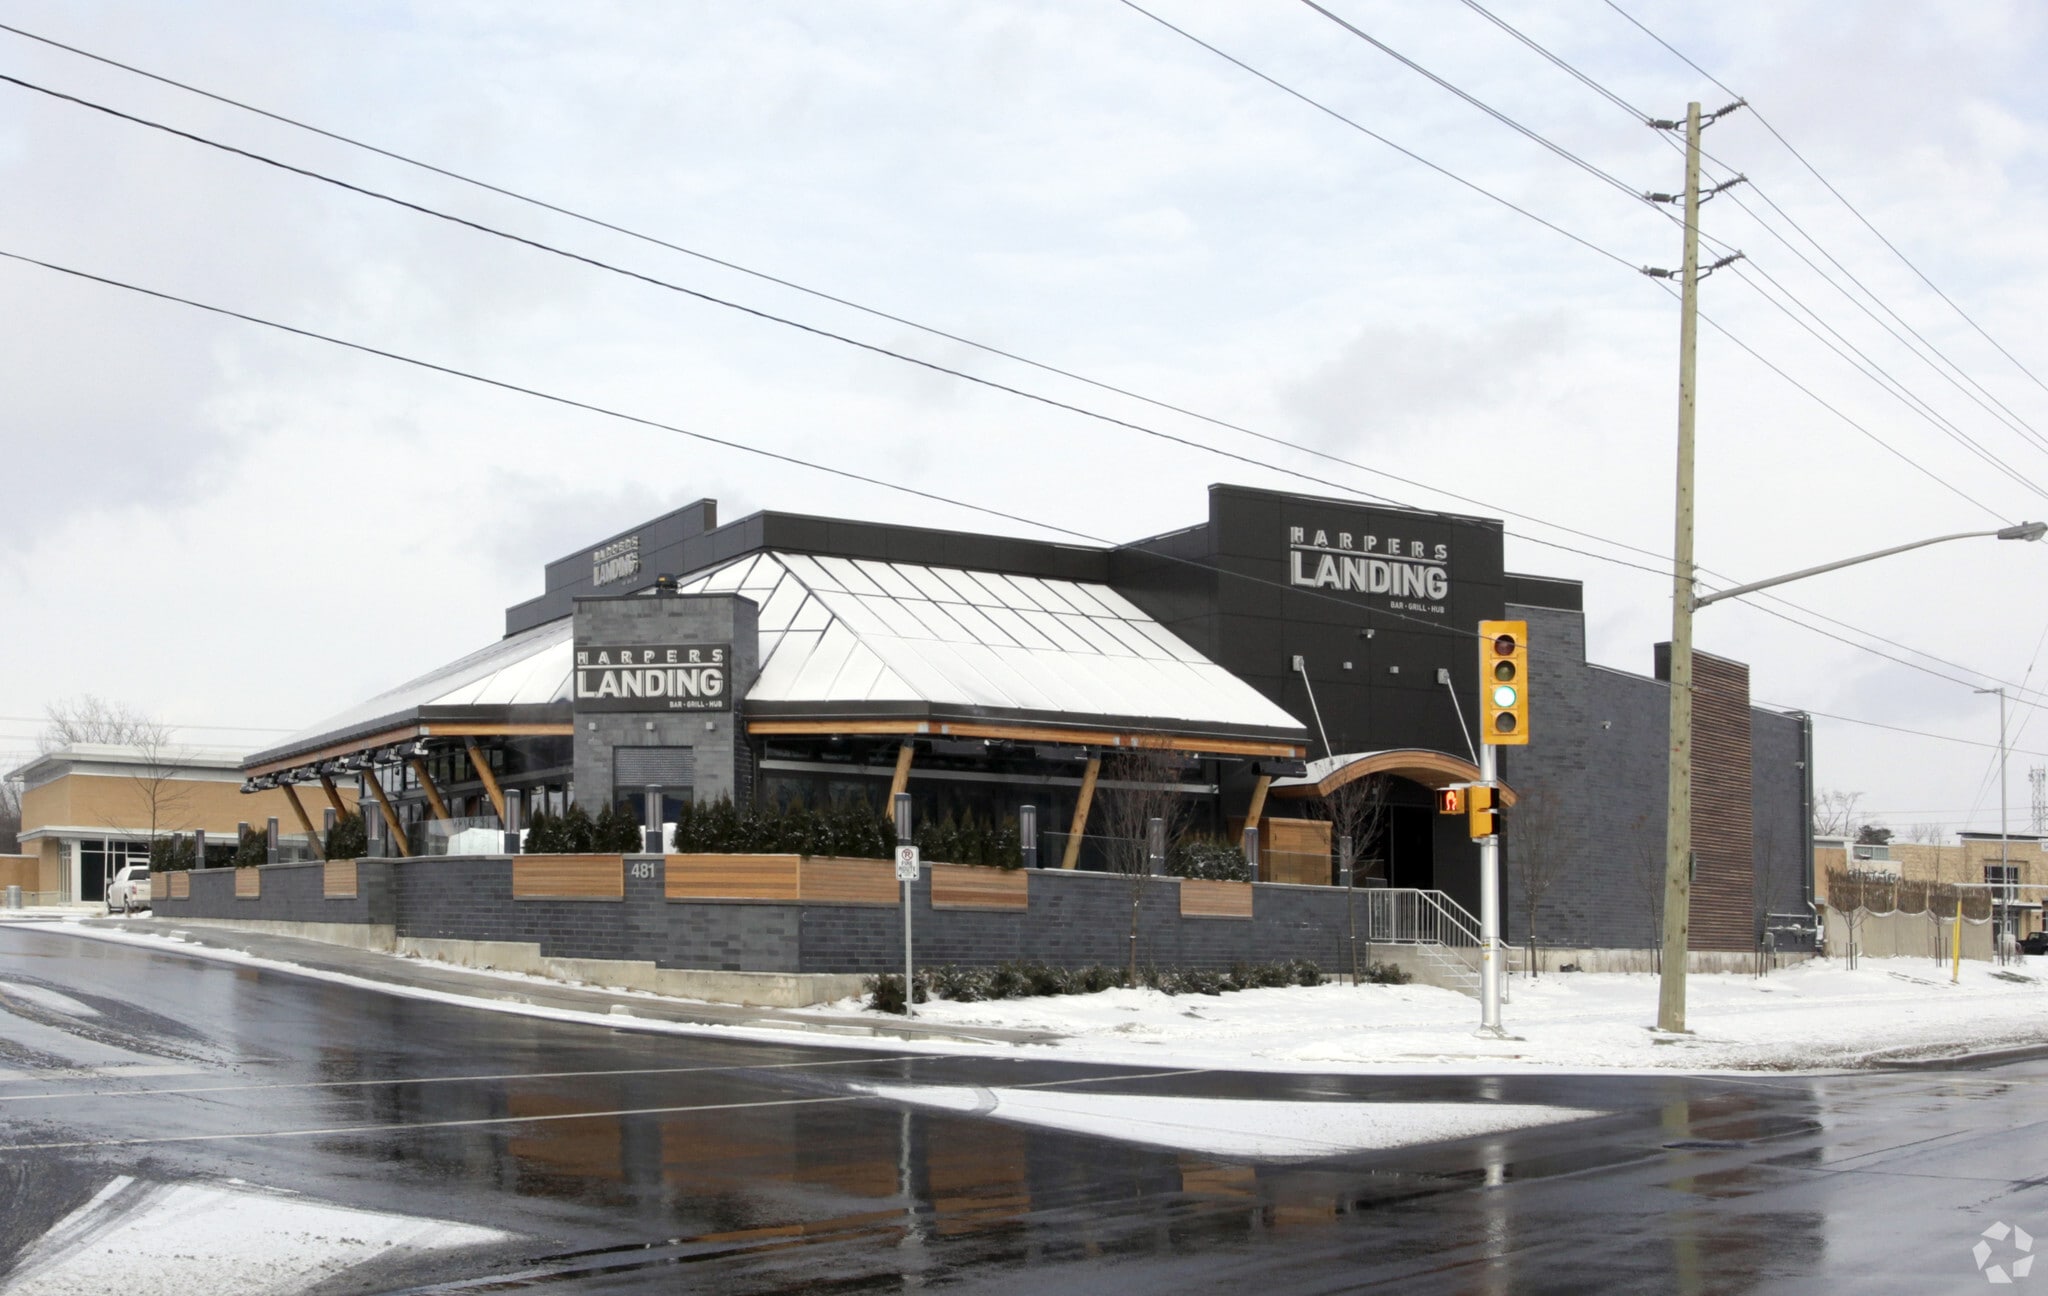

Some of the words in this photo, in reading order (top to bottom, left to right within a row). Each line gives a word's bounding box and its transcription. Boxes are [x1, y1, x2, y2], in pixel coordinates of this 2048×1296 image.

[1290, 526, 1448, 560] HARPERS
[593, 552, 638, 586] LANDING
[1290, 550, 1448, 600] LANDING
[577, 649, 723, 664] HARPERS
[577, 668, 723, 698] LANDING
[631, 863, 655, 878] 481
